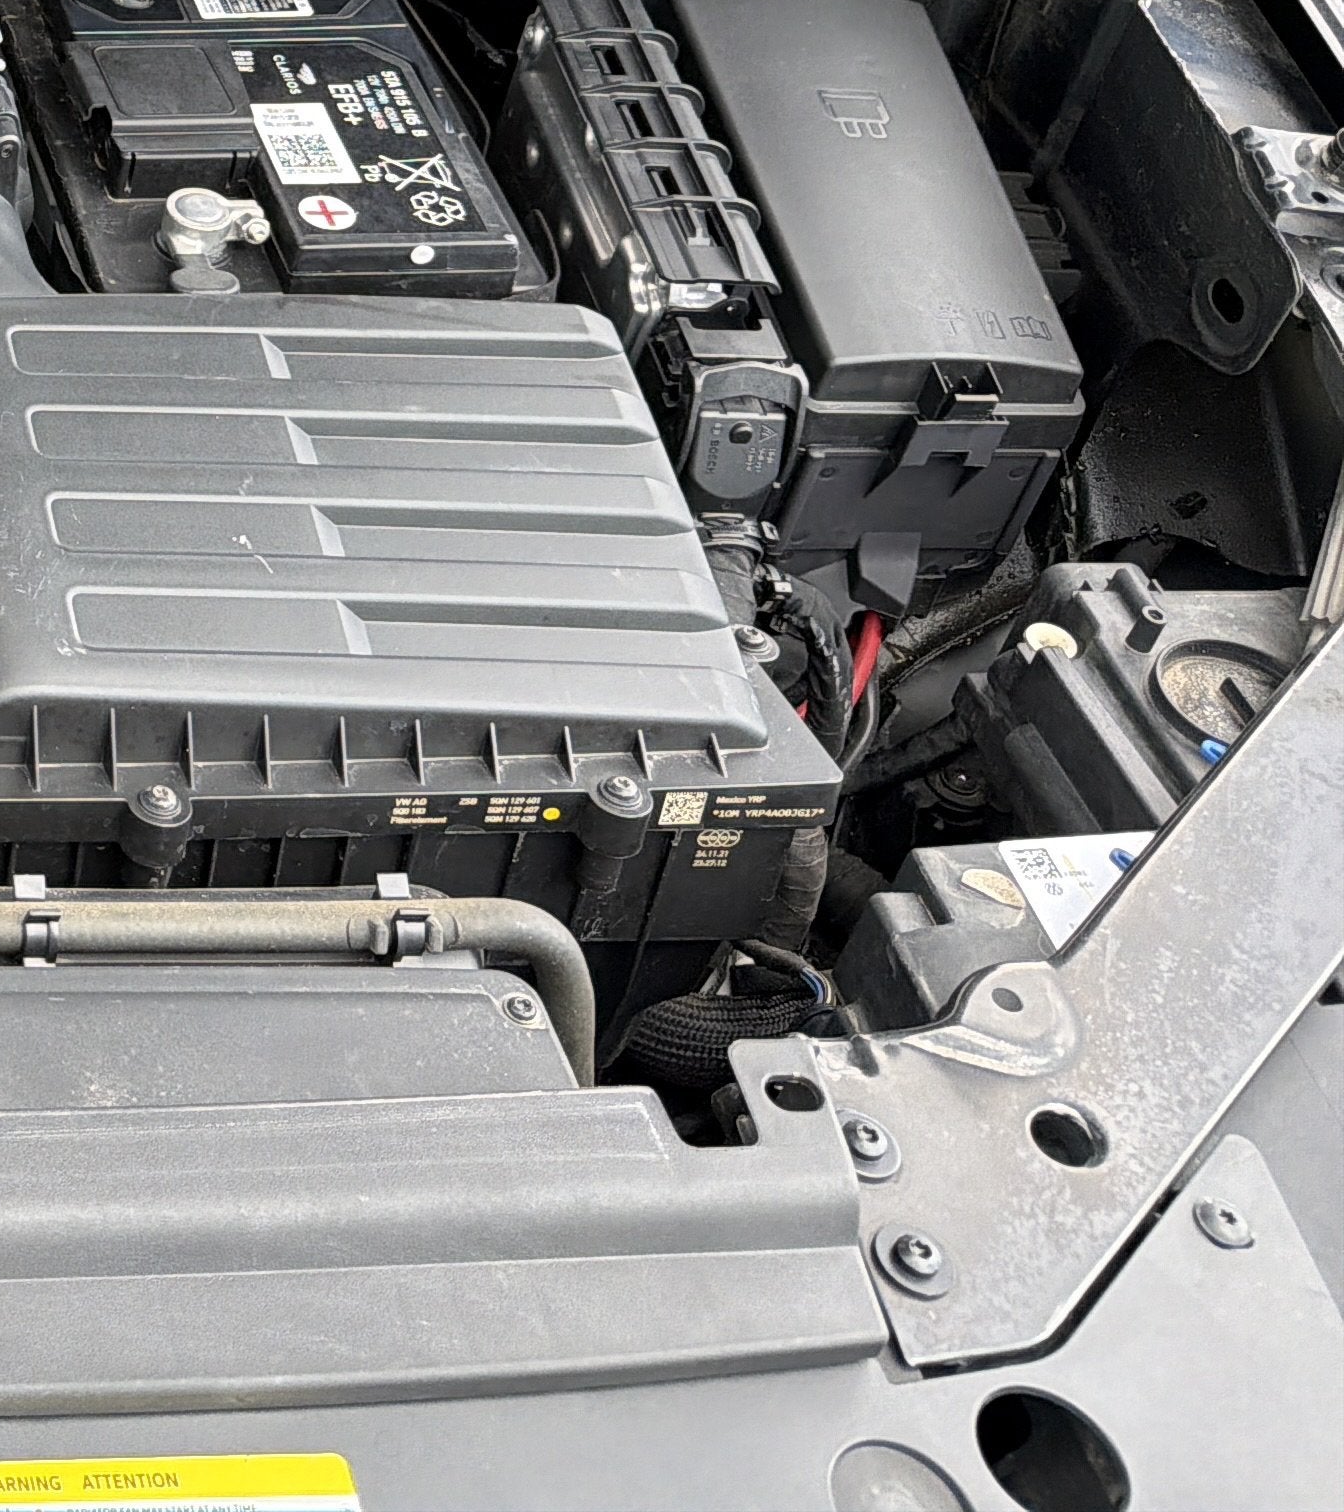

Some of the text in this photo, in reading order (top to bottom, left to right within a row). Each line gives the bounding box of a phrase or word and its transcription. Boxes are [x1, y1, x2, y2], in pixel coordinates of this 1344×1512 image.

[273, 54, 302, 95] CLARIOS
[327, 83, 365, 126] EFB+
[360, 164, 384, 183] Pb
[716, 795, 766, 804] Mexico YRP
[82, 1473, 179, 1490] ATTENTION
